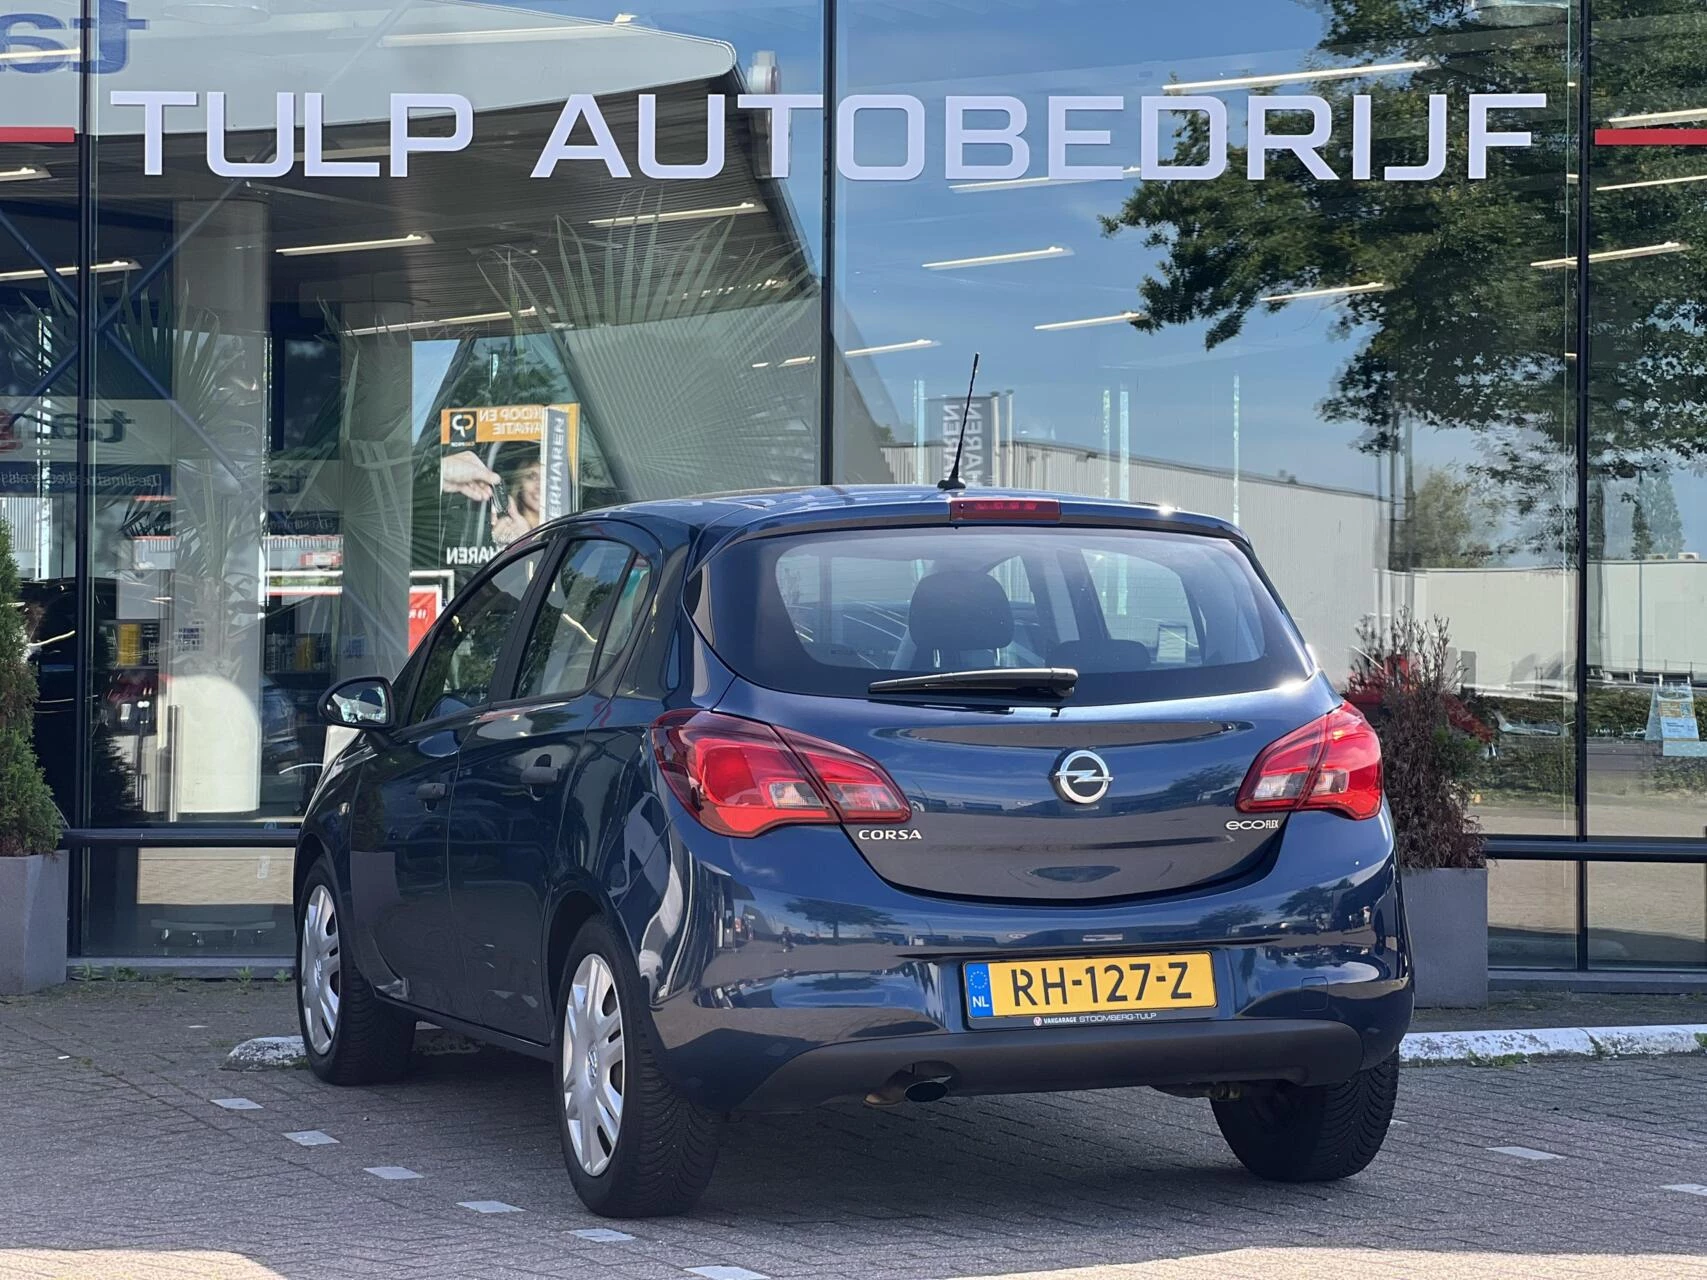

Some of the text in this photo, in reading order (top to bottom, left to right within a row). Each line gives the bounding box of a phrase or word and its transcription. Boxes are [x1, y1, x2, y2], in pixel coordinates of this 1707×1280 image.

[111, 91, 1546, 181] TULP AUTOBEDRIJF
[549, 416, 565, 520] ERHAREN
[858, 829, 922, 840] CORSA
[972, 961, 1192, 1008] NL RH-127-Z
[1078, 1012, 1157, 1023] STOOMBERG-TULP
